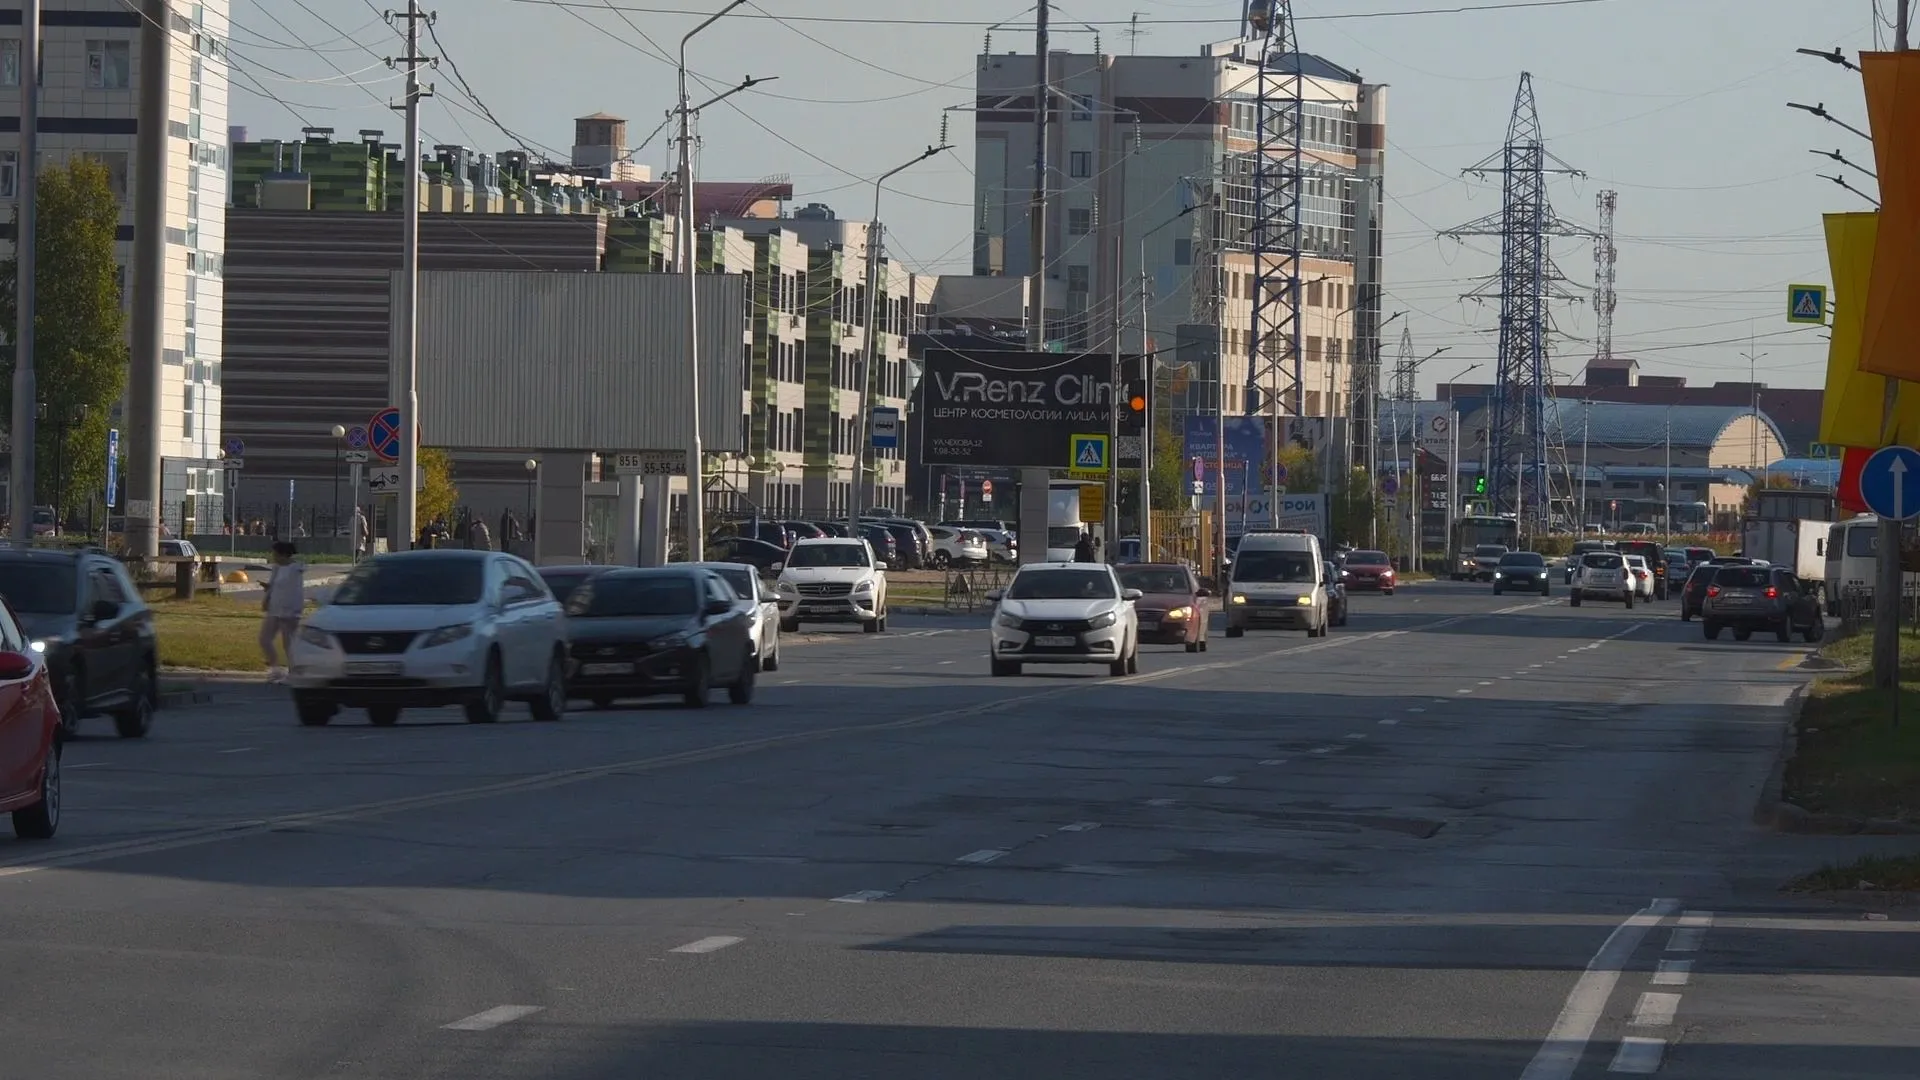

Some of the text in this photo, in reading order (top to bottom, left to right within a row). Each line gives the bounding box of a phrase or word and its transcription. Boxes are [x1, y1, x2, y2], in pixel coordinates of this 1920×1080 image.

[934, 371, 1047, 405] V.Renz
[933, 407, 968, 419] ЦЕНТР
[971, 408, 1063, 421] КОСМЕТОЛОГИИ
[1065, 410, 1097, 423] ЛИЦА
